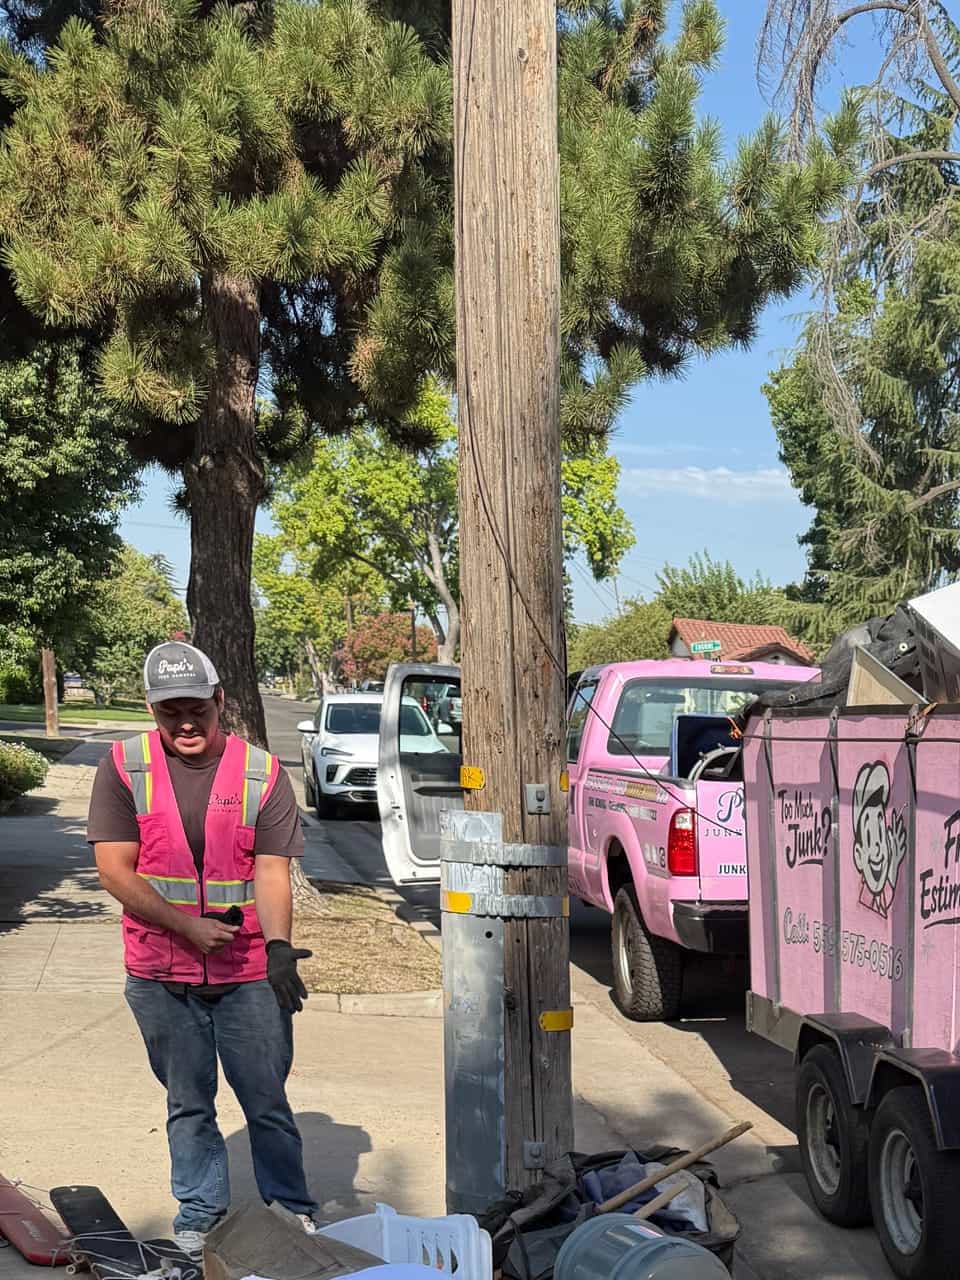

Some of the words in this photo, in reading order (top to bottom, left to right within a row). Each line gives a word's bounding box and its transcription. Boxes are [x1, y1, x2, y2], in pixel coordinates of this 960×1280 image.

[158, 657, 194, 674] Papi's
[778, 789, 793, 824] Too
[794, 790, 814, 820] Much
[785, 806, 832, 869] Junk?
[718, 864, 747, 875] JUNK
[841, 930, 904, 982] 575-0516
